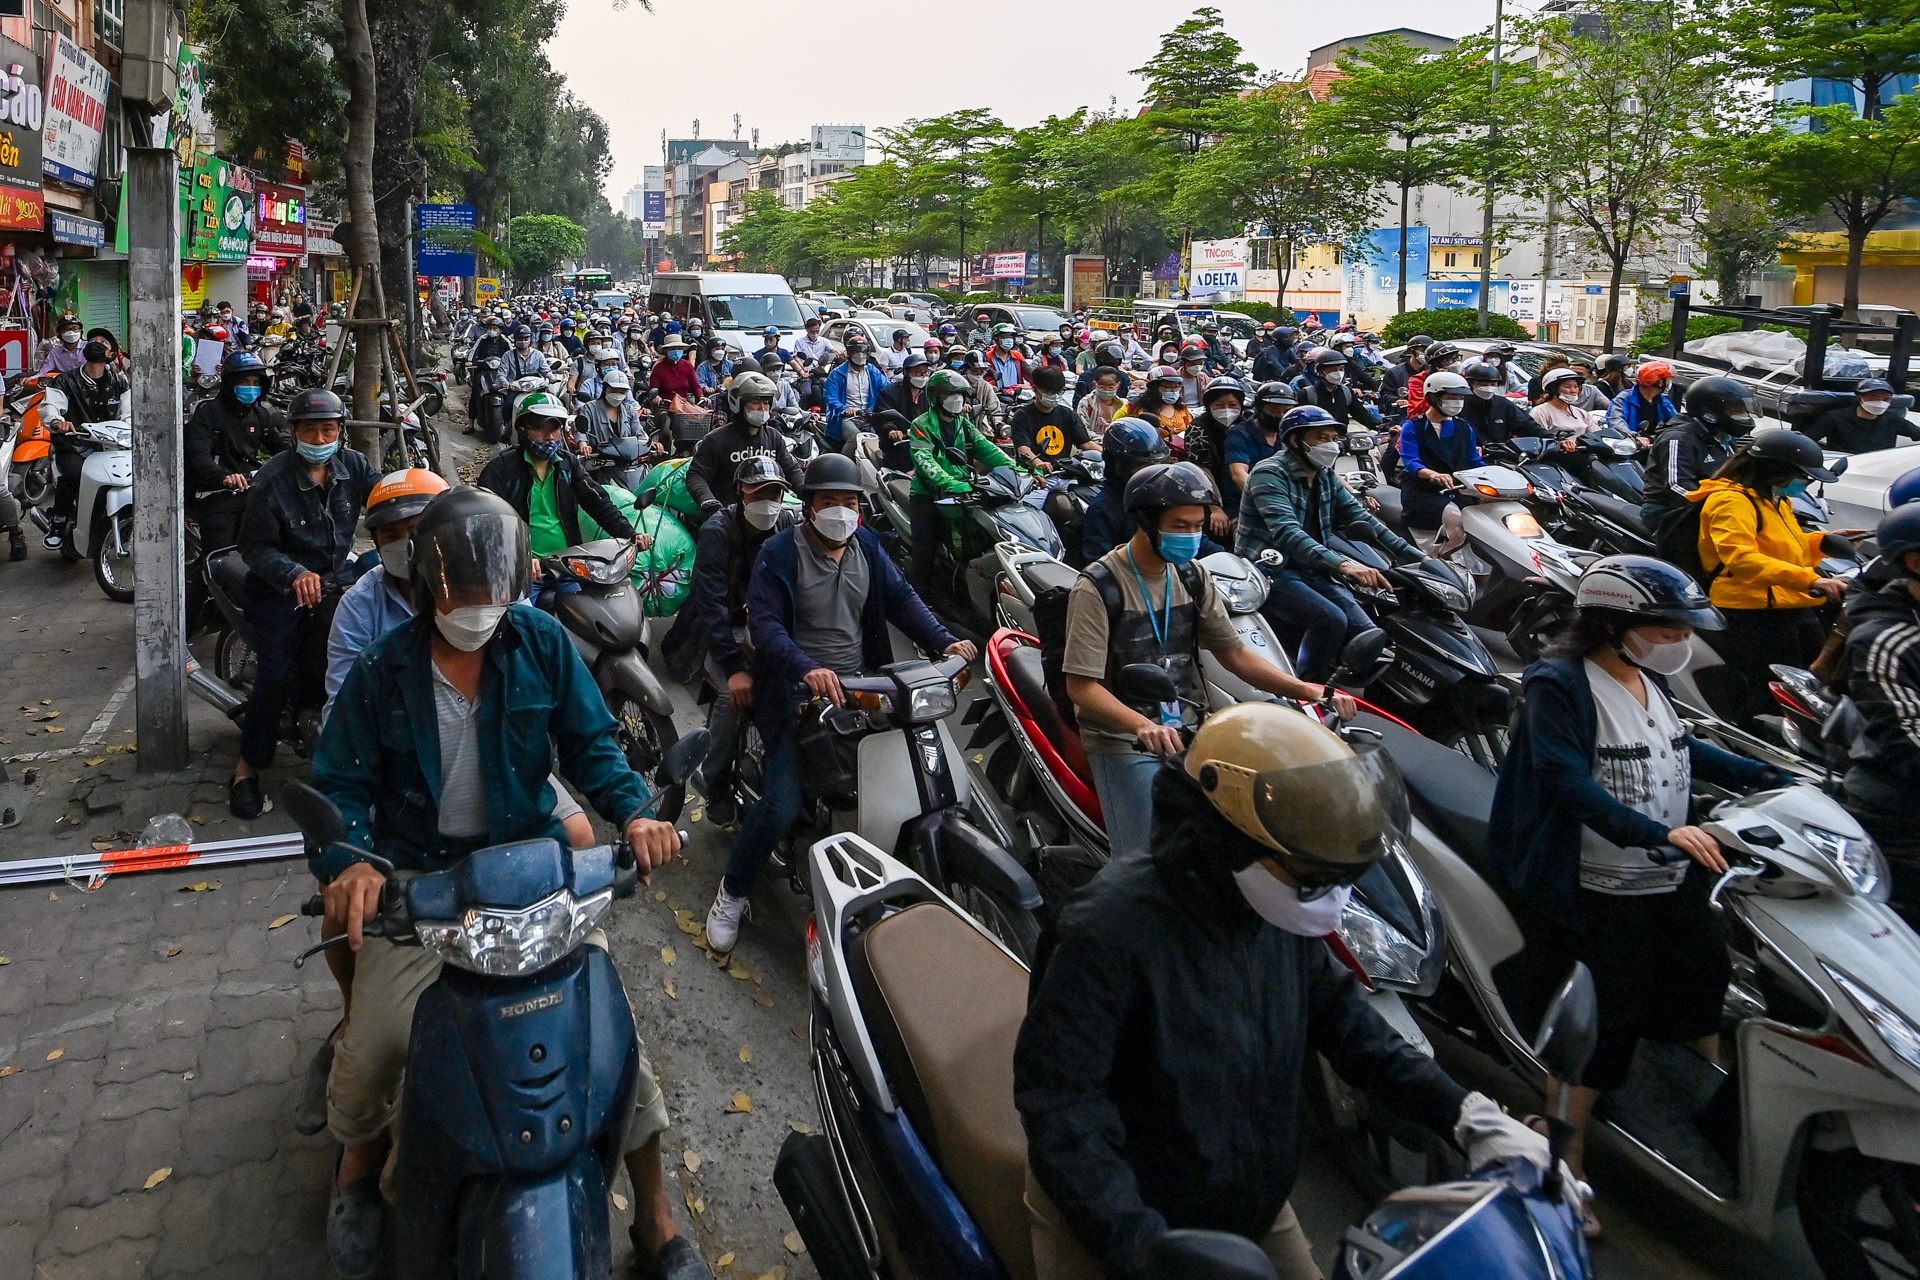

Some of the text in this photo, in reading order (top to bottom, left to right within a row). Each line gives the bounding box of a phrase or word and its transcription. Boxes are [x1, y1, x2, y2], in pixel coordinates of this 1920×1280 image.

[259, 192, 287, 226] Quảng
[1205, 248, 1234, 258] TNCons
[1204, 272, 1238, 286] DELTA
[1380, 276, 1392, 288] 12
[730, 445, 776, 463] adidas
[1401, 661, 1435, 688] YAMAHA
[500, 993, 562, 1018] HONDA
